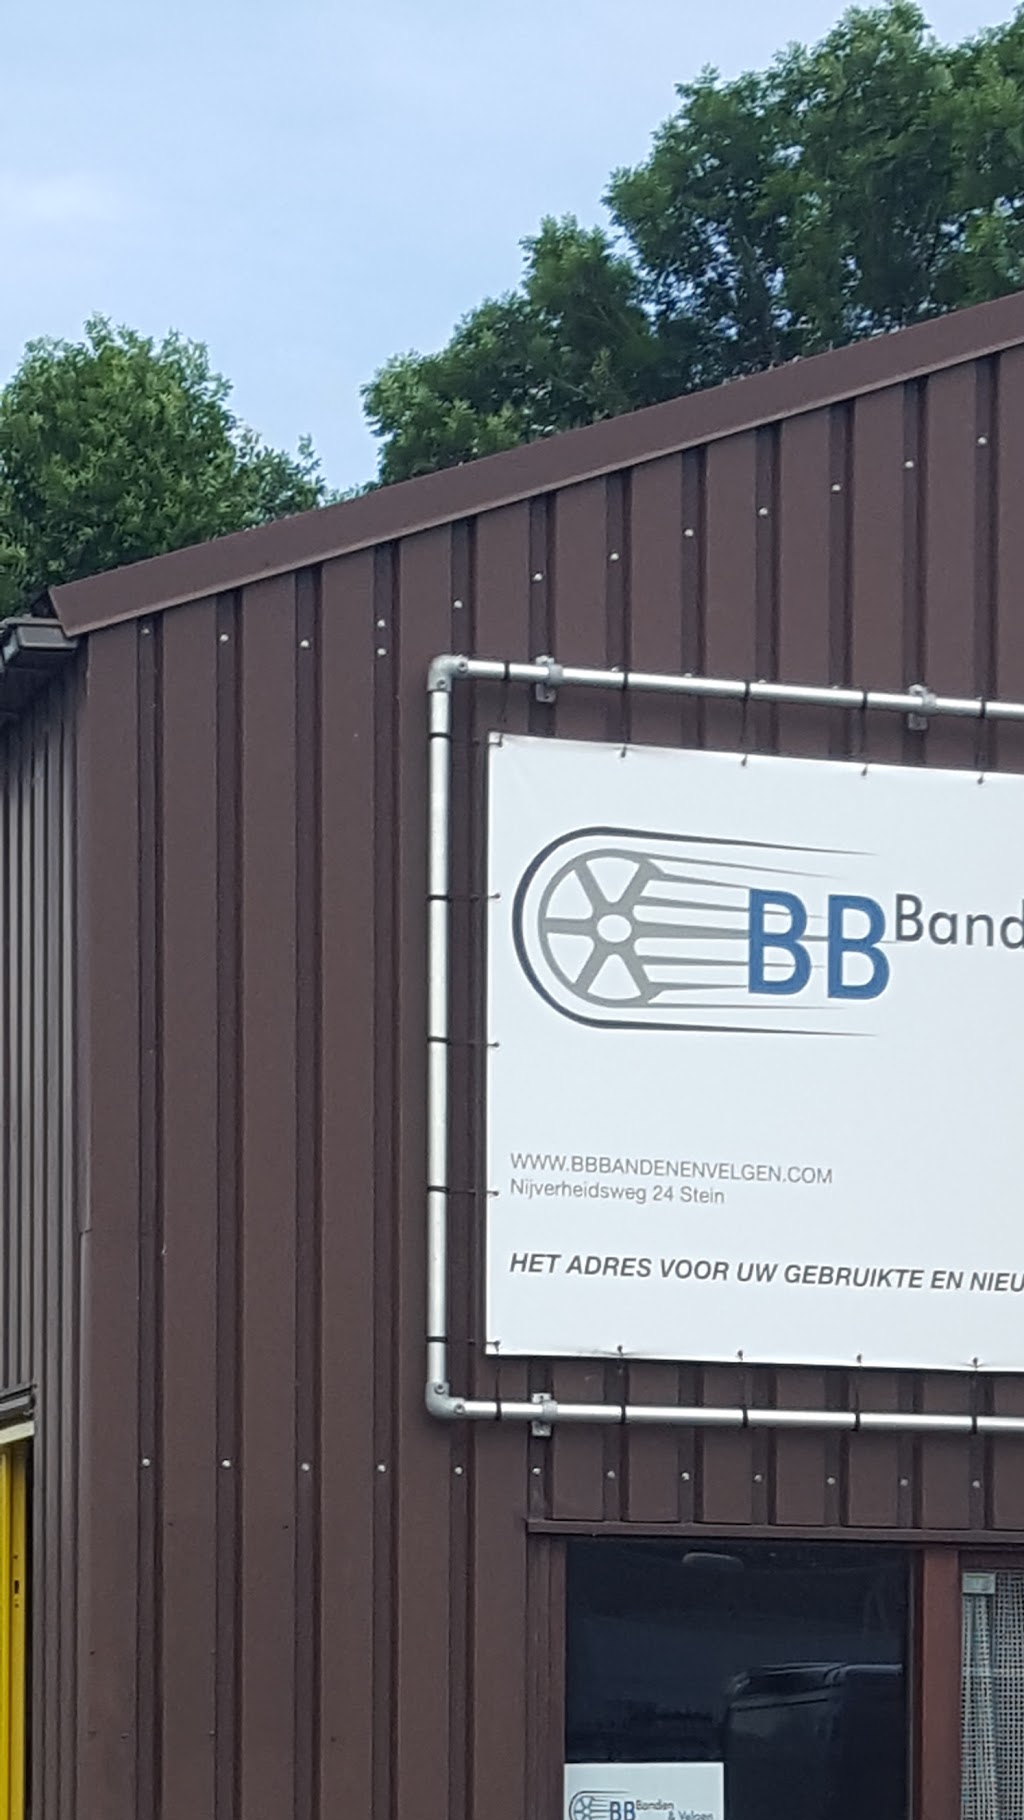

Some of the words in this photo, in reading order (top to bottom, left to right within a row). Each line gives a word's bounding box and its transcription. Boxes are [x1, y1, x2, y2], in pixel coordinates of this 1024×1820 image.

[748, 889, 890, 1000] BB
[510, 1153, 832, 1184] WWW.BBBANDENENVELGEN.COM
[510, 1178, 646, 1204] Nijverheidsweg
[653, 1185, 674, 1201] 24
[680, 1186, 725, 1204] Stein
[509, 1253, 562, 1274] HET
[566, 1255, 652, 1278] ADRES
[659, 1259, 730, 1281] VOOR
[736, 1262, 778, 1283] UW
[783, 1264, 924, 1290] GEBRUIKTE
[930, 1270, 964, 1290] EN
